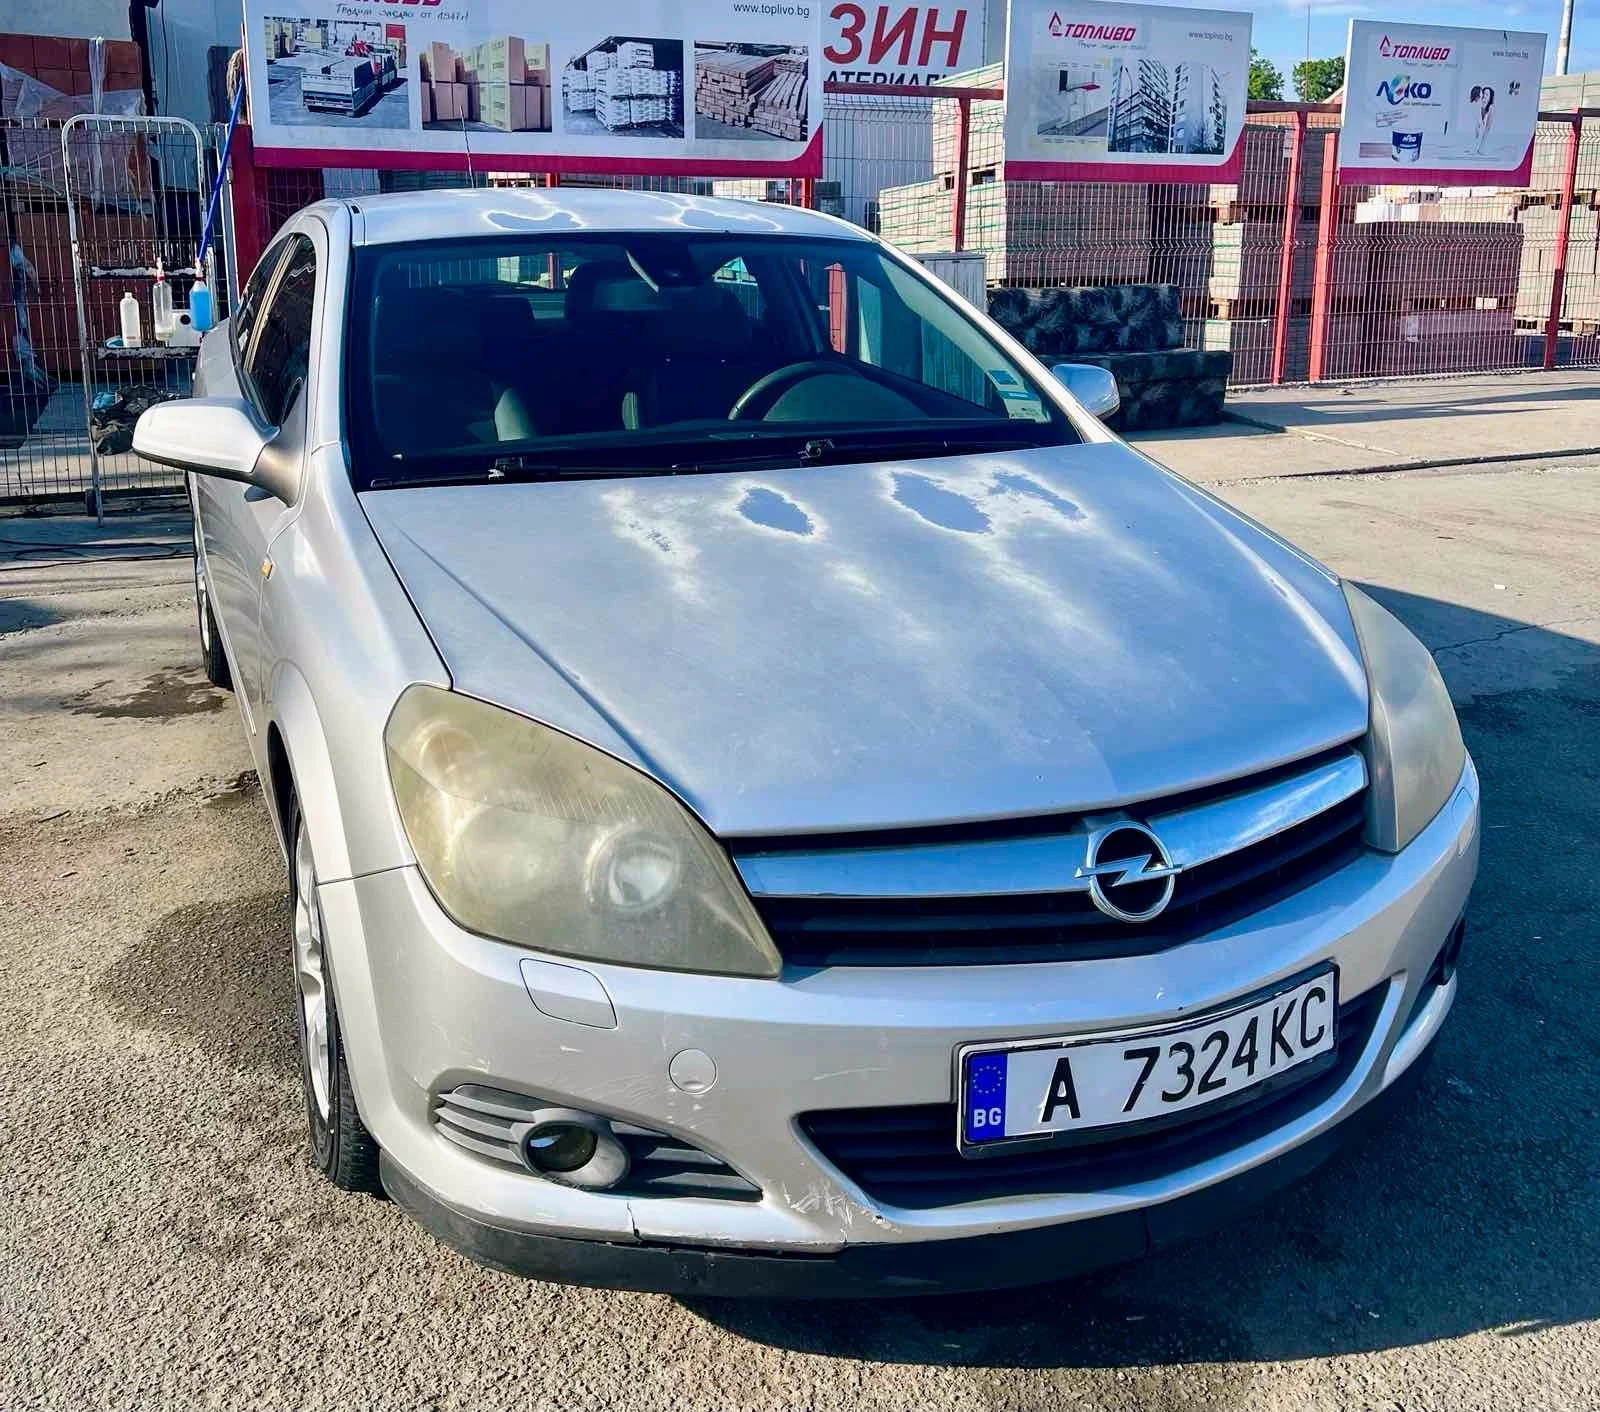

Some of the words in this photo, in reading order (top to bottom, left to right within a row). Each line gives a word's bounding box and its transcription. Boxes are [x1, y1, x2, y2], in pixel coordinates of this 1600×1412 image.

[734, 3, 810, 18] www.toplivo.bg
[1041, 1057, 1081, 1123] A
[973, 1107, 1002, 1128] BG
